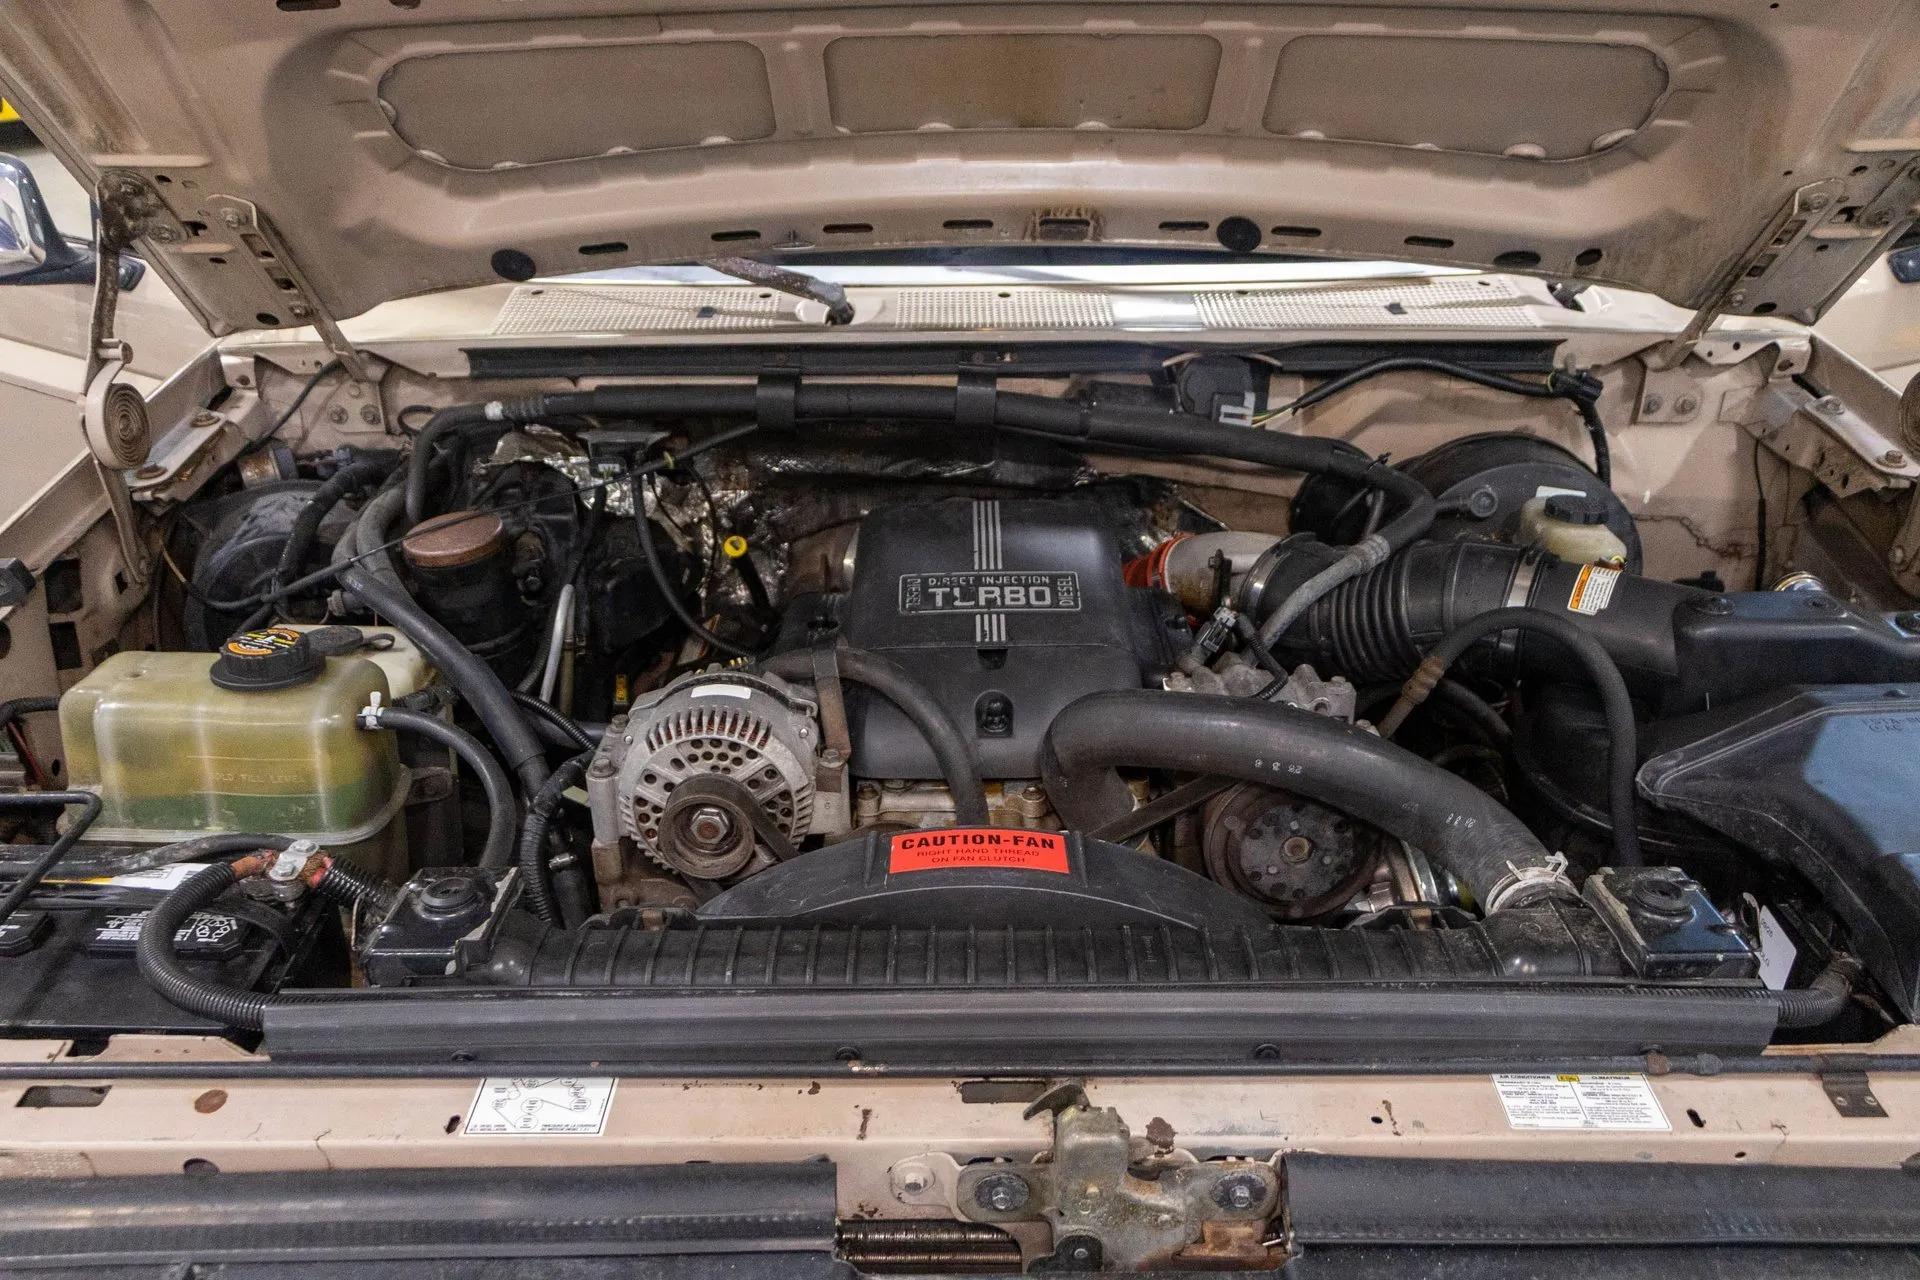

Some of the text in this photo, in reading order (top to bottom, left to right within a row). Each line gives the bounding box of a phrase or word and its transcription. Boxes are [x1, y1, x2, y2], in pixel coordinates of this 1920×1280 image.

[928, 575, 1050, 585] DRECT INJECTION
[1057, 575, 1074, 606] DIESEL
[901, 833, 1055, 850] CAUTION-FAN
[917, 848, 951, 857] RIGHT
[993, 848, 1040, 857] THREAD
[979, 855, 1025, 863] CLUTCH
